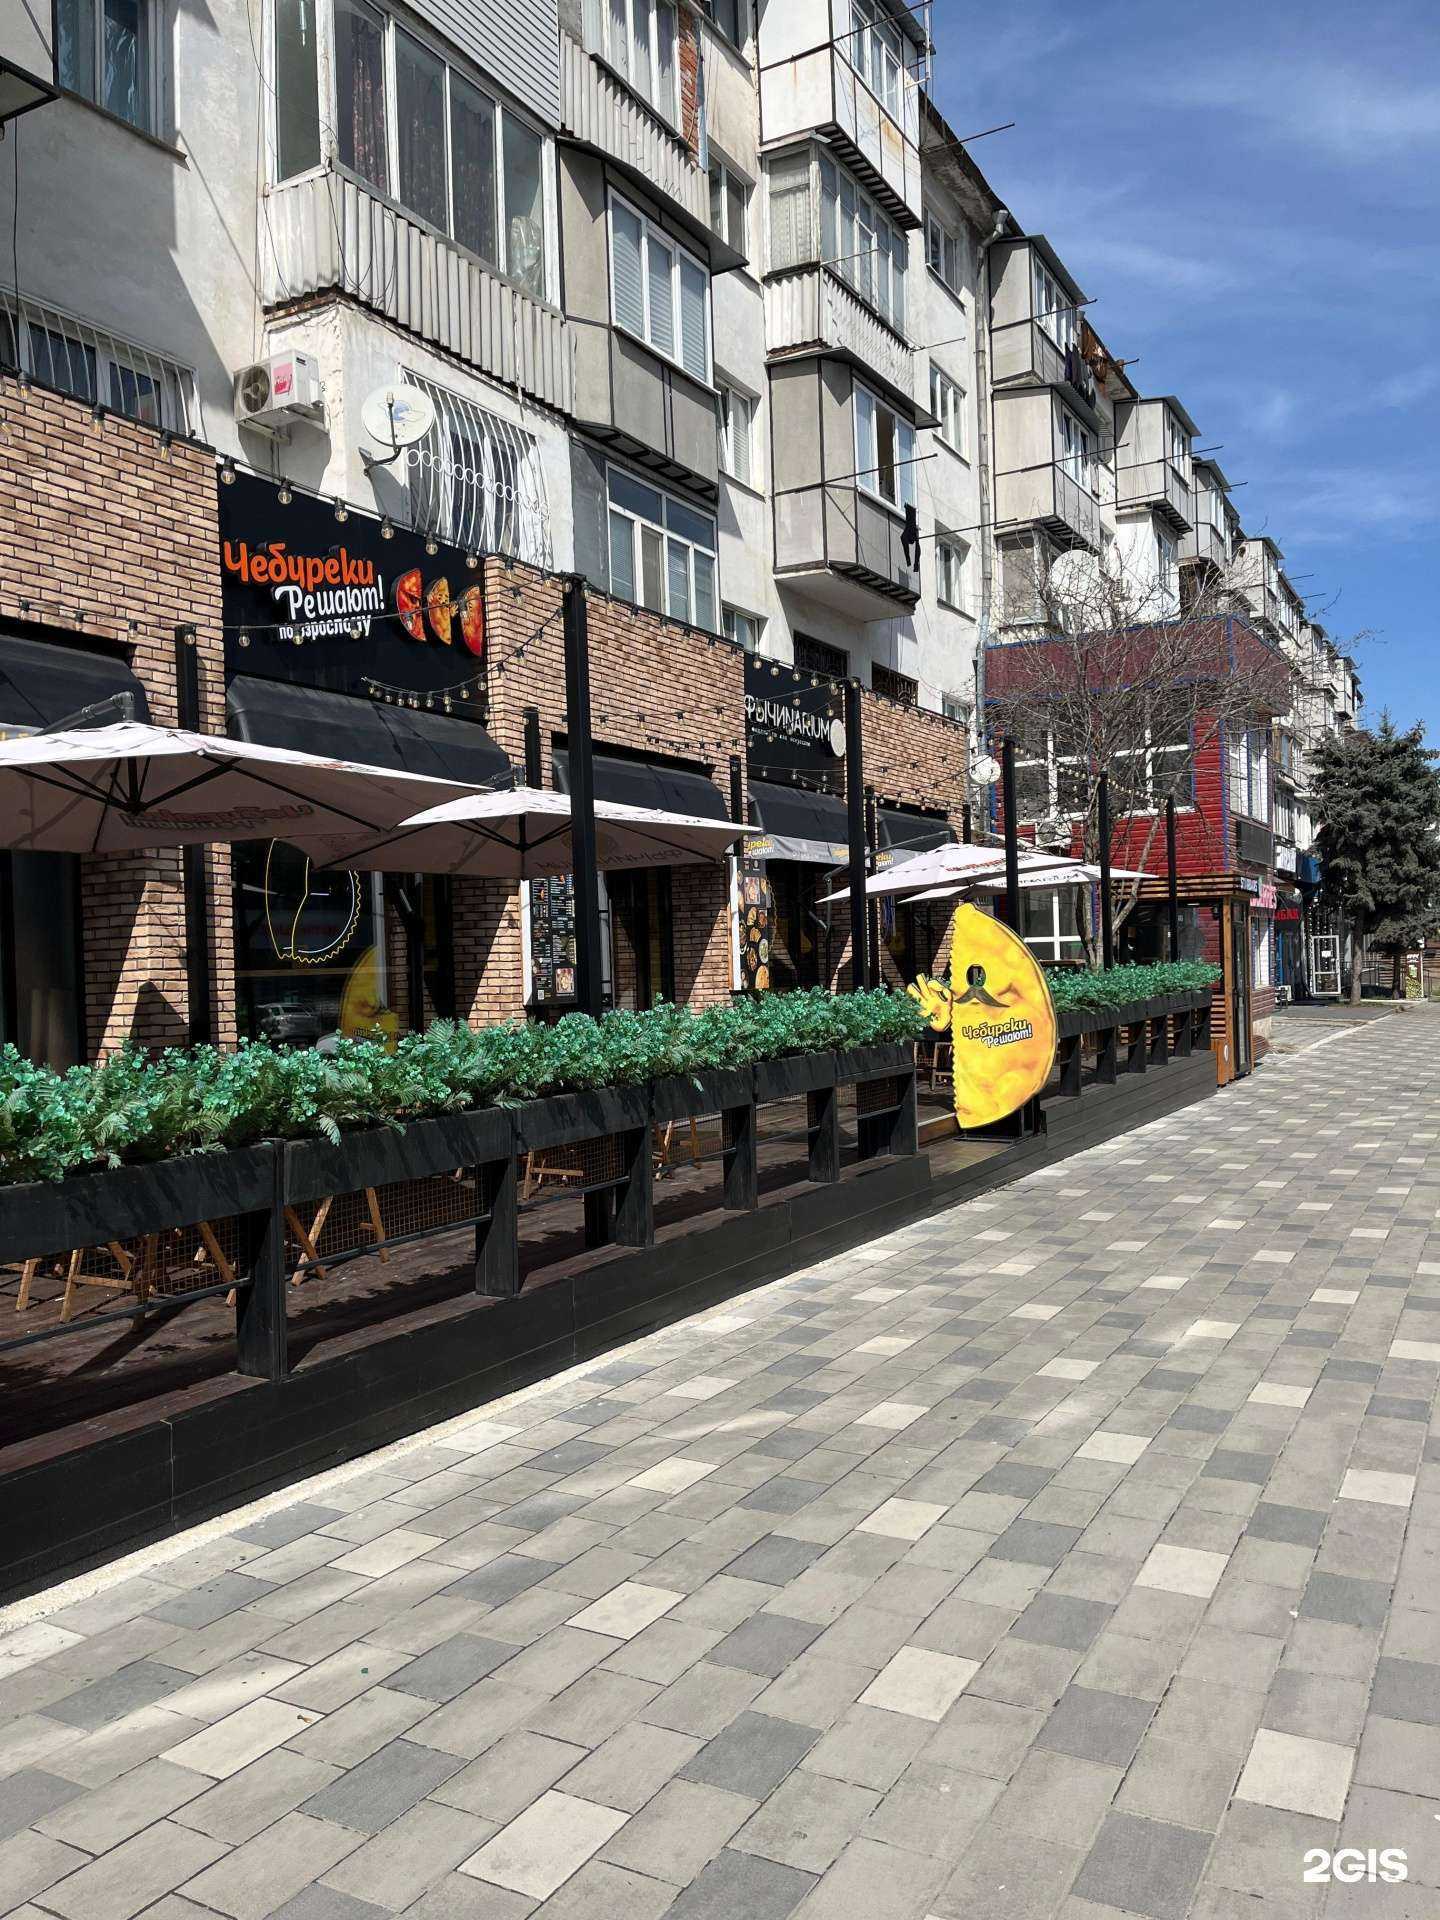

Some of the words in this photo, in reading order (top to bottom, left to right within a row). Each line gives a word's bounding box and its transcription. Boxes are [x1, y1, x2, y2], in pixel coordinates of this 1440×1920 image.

[223, 539, 374, 592] Чебуреки
[275, 574, 385, 620] Решают!
[961, 1018, 1028, 1040] Чебуреки
[981, 1023, 1033, 1048] Решают!
